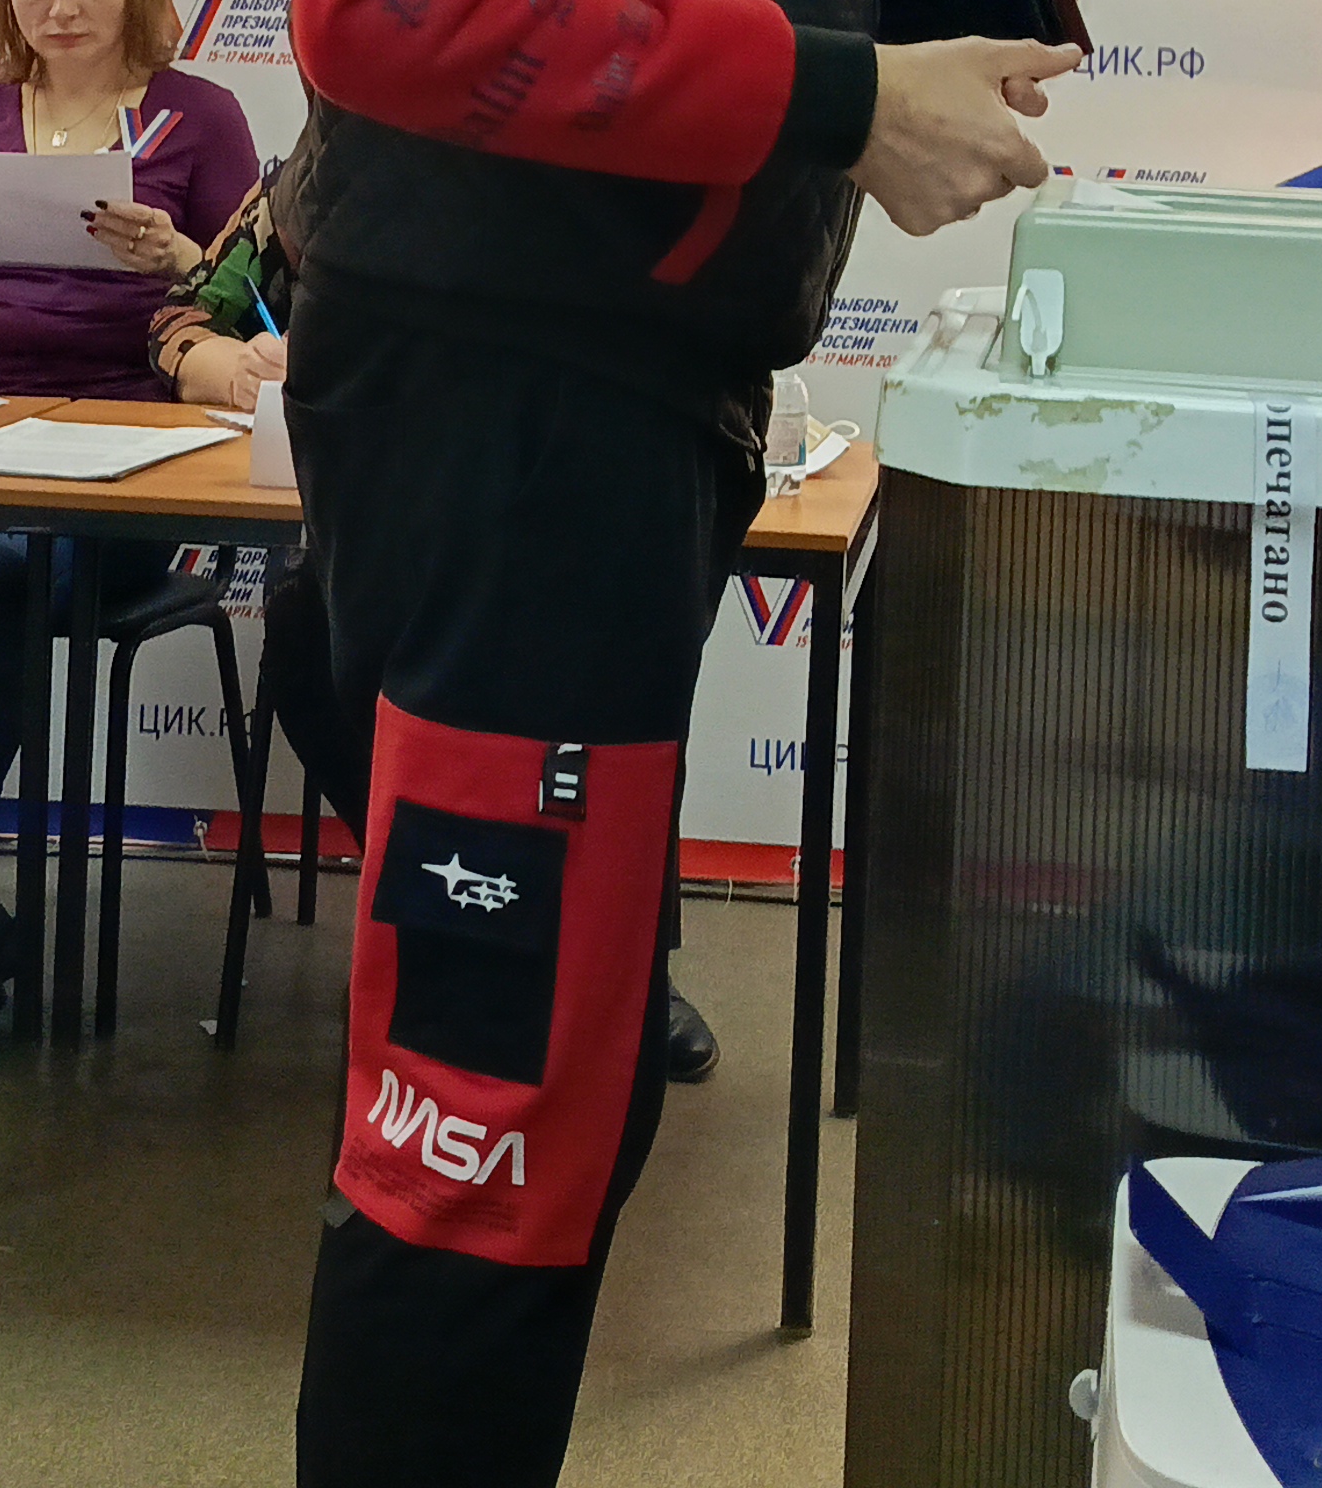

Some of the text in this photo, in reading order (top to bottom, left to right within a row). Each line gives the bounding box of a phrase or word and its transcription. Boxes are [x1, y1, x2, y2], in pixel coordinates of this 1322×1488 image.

[213, 32, 275, 49] РОССИИ
[238, 51, 275, 64] МАРТА
[822, 335, 875, 351] ОССИИ
[837, 355, 875, 368] МАРТА
[367, 1068, 525, 1186] NASA
